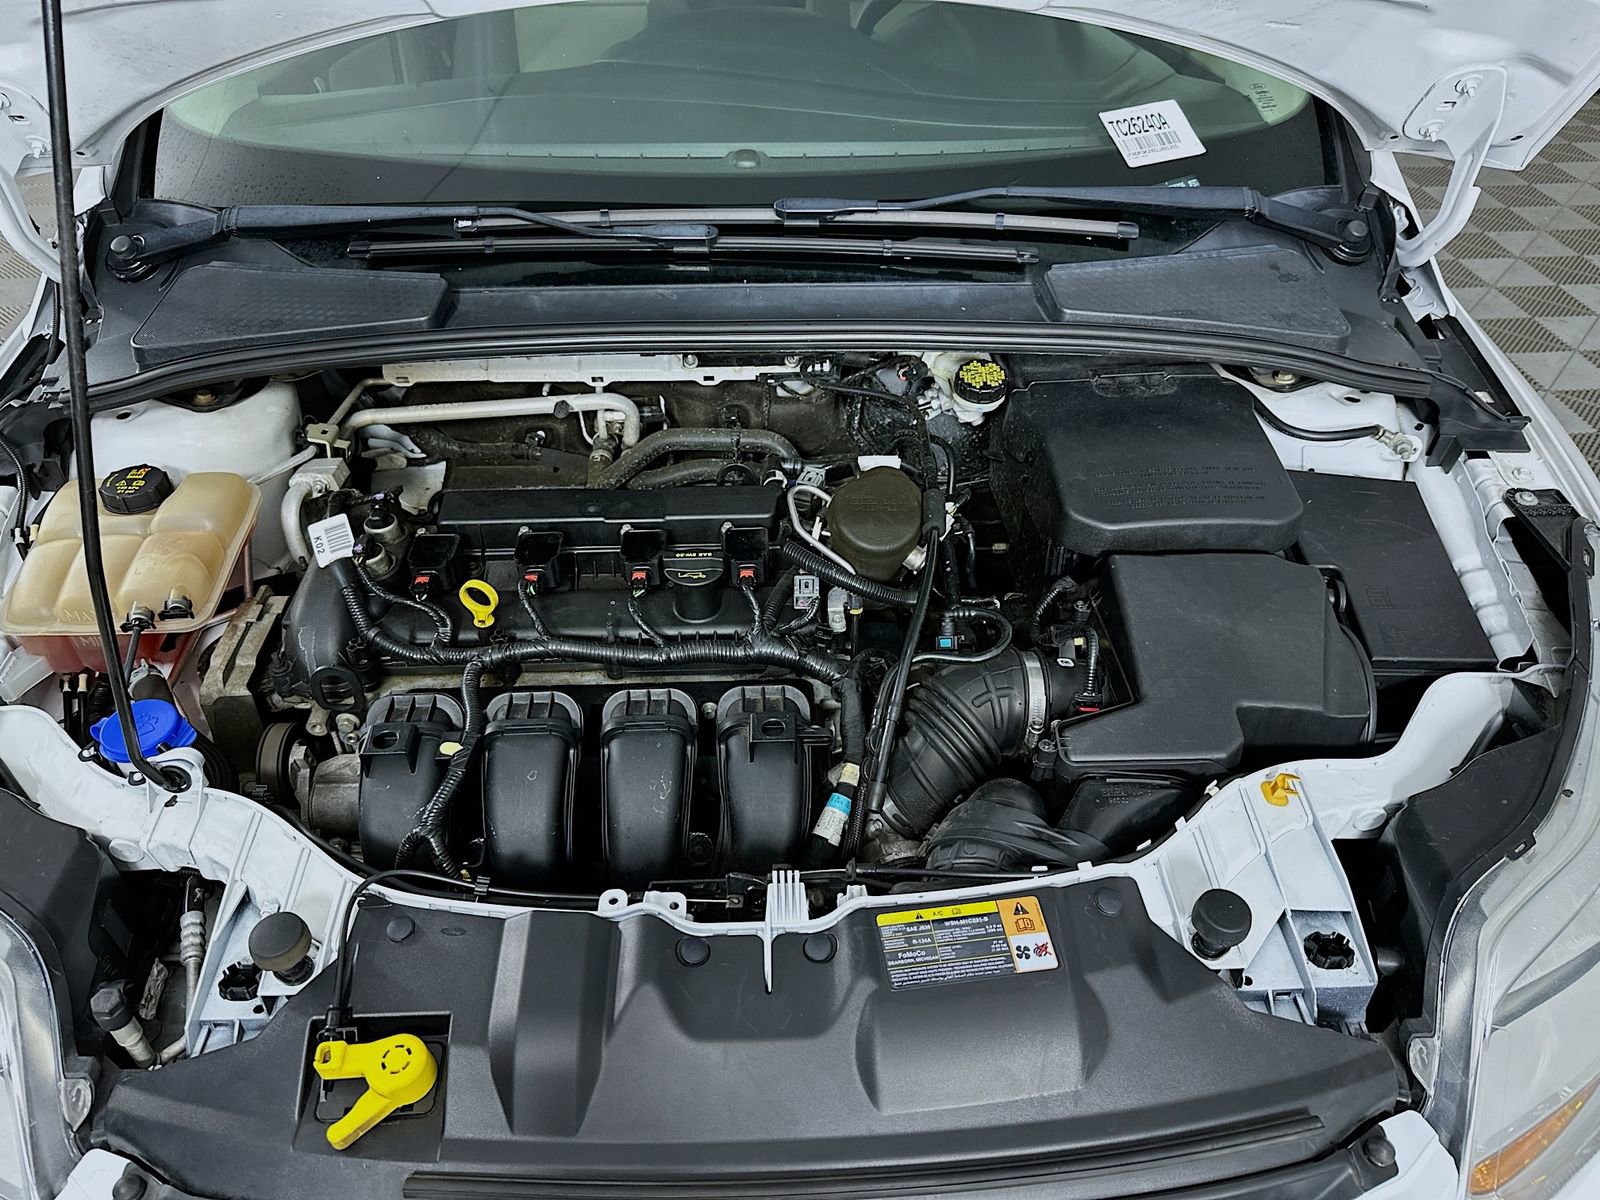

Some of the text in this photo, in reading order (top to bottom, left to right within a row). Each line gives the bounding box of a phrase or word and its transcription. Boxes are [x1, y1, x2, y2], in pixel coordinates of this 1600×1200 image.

[1108, 112, 1171, 138] TC26240A
[313, 535, 326, 555] K02
[912, 937, 932, 945] R-134A
[897, 950, 927, 959] FoMoCo
[916, 955, 939, 964] MICHIGAN
